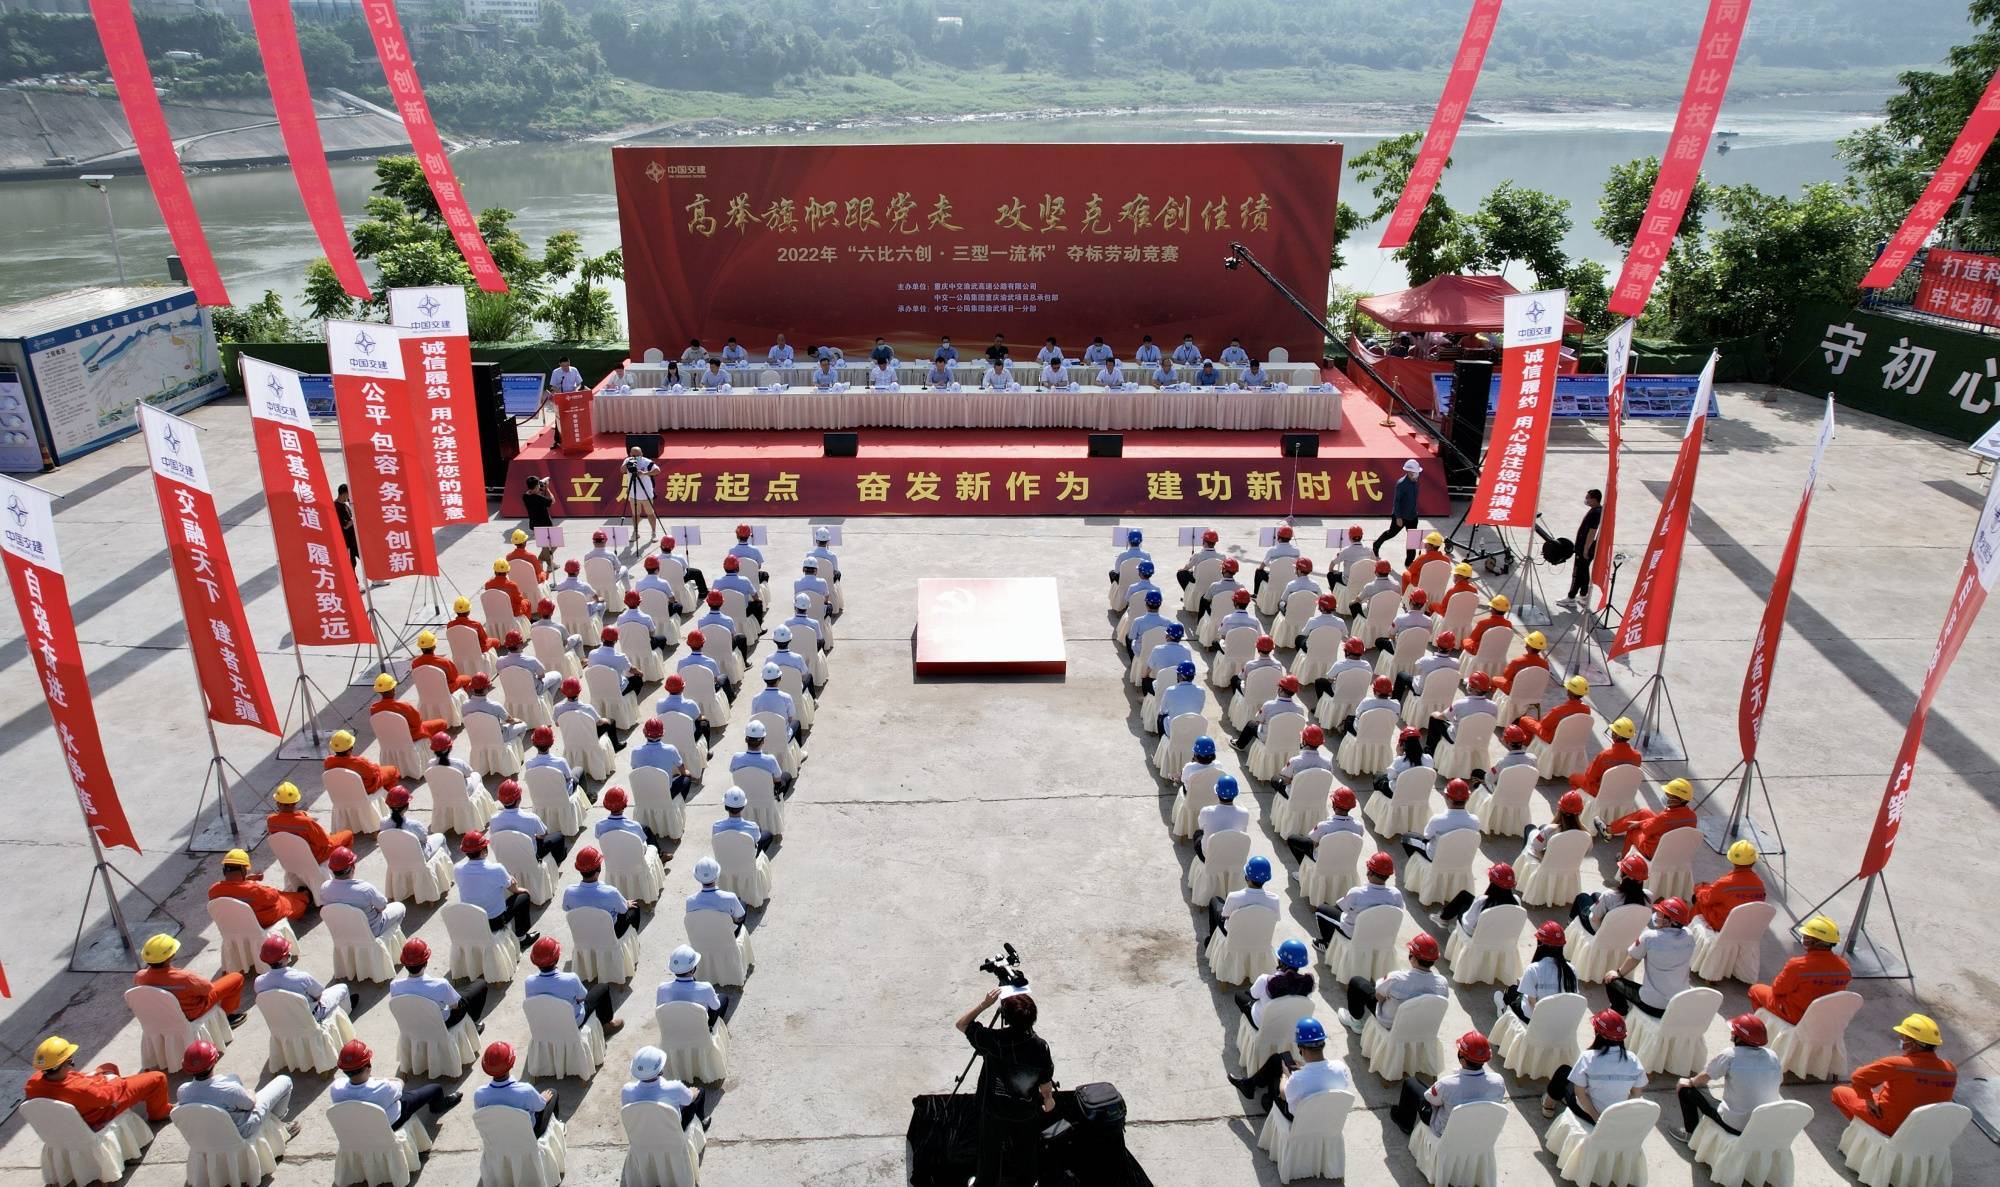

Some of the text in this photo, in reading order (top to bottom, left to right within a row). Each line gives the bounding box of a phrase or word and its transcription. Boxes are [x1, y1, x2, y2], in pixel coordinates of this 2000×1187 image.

[370, 3, 427, 125] 习比创新
[425, 153, 494, 275] 创智能精品
[1395, 102, 1462, 228] 创优质精品
[685, 192, 1273, 237] 高举旗帜跟党走 攻坚克难创佳绩
[1620, 188, 1682, 300] 创匠心精品
[1880, 142, 1982, 268] 创高效精品
[349, 358, 388, 370] 中国交建
[410, 321, 452, 330] 中国交建
[1518, 326, 1552, 337] 中国交建
[266, 401, 298, 418] 中国交建
[420, 341, 451, 400] 诚信履约
[1518, 349, 1545, 409] 诚信履约
[161, 456, 194, 478] 中国交建
[430, 407, 466, 521] 用心浇注您的满意
[857, 470, 1089, 502] 奋发新作为
[1147, 470, 1383, 502] 建功新时代
[1486, 416, 1534, 521] 用心浇注您的满意
[278, 427, 323, 532] 固基修道
[306, 542, 351, 640] 履方致远
[24, 567, 69, 708] 自强奋进
[174, 488, 221, 603] 交融天下
[208, 618, 263, 724] 建者无疆
